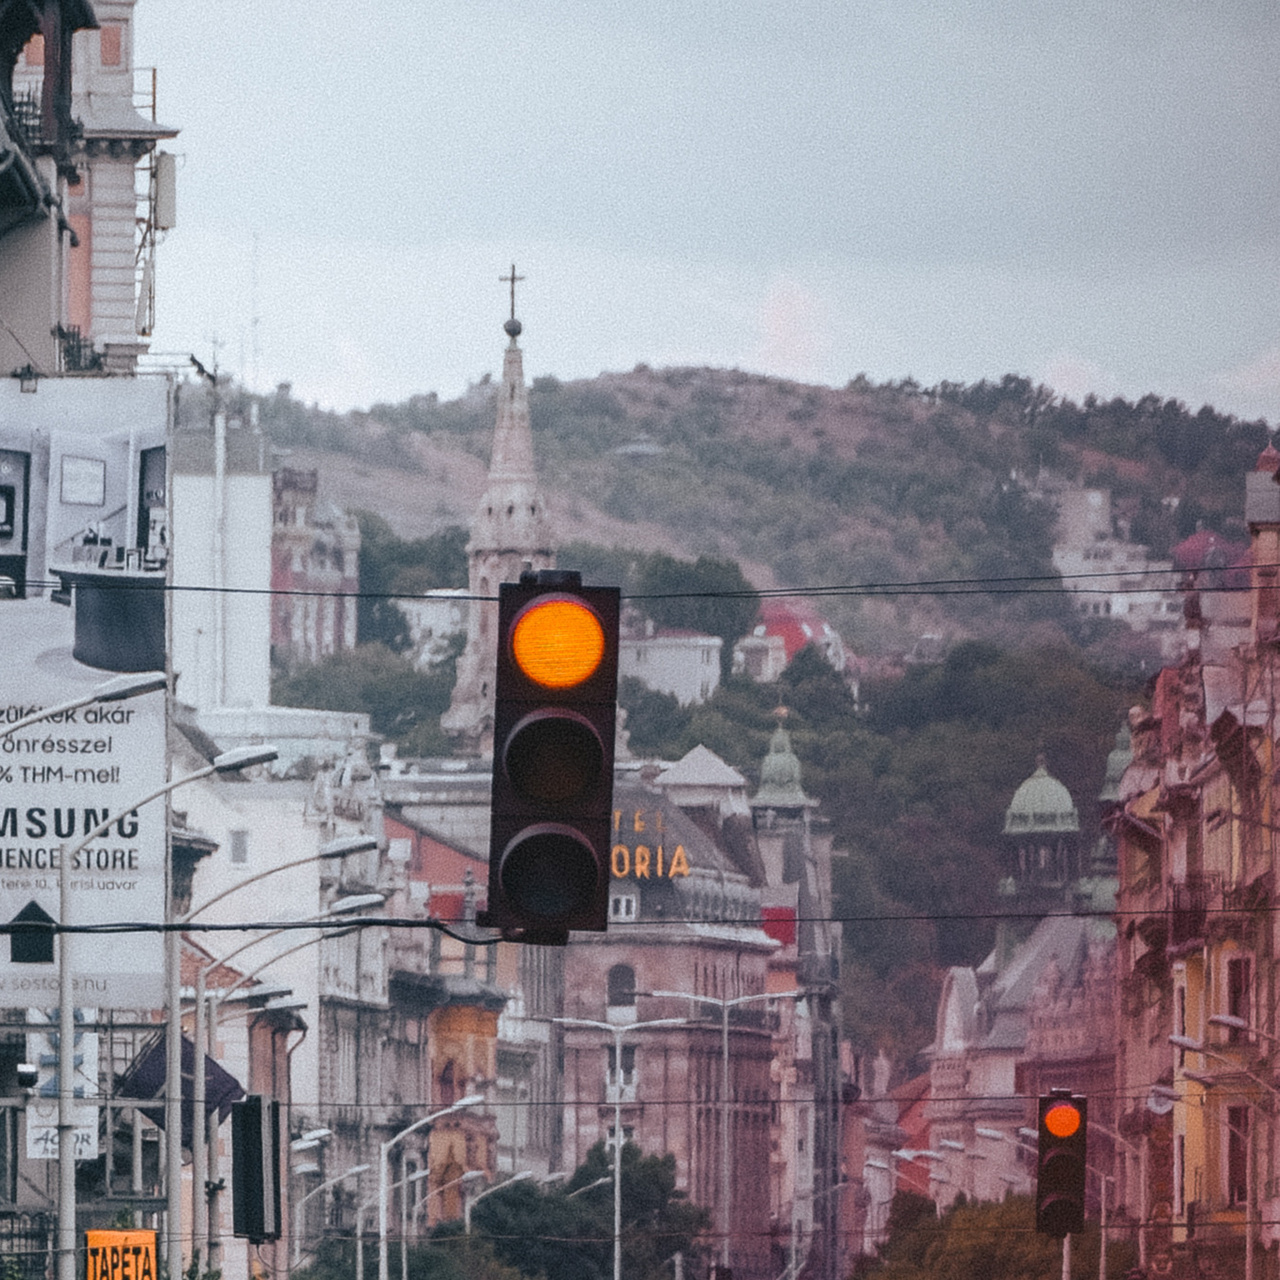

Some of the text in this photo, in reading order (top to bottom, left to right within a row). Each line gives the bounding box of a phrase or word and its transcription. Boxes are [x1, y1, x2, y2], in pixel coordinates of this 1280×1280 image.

[84, 706, 135, 724] akár
[21, 765, 121, 784] THM-mel!
[613, 808, 668, 833] TEL
[72, 849, 139, 871] STORE
[611, 843, 690, 879] ORIA
